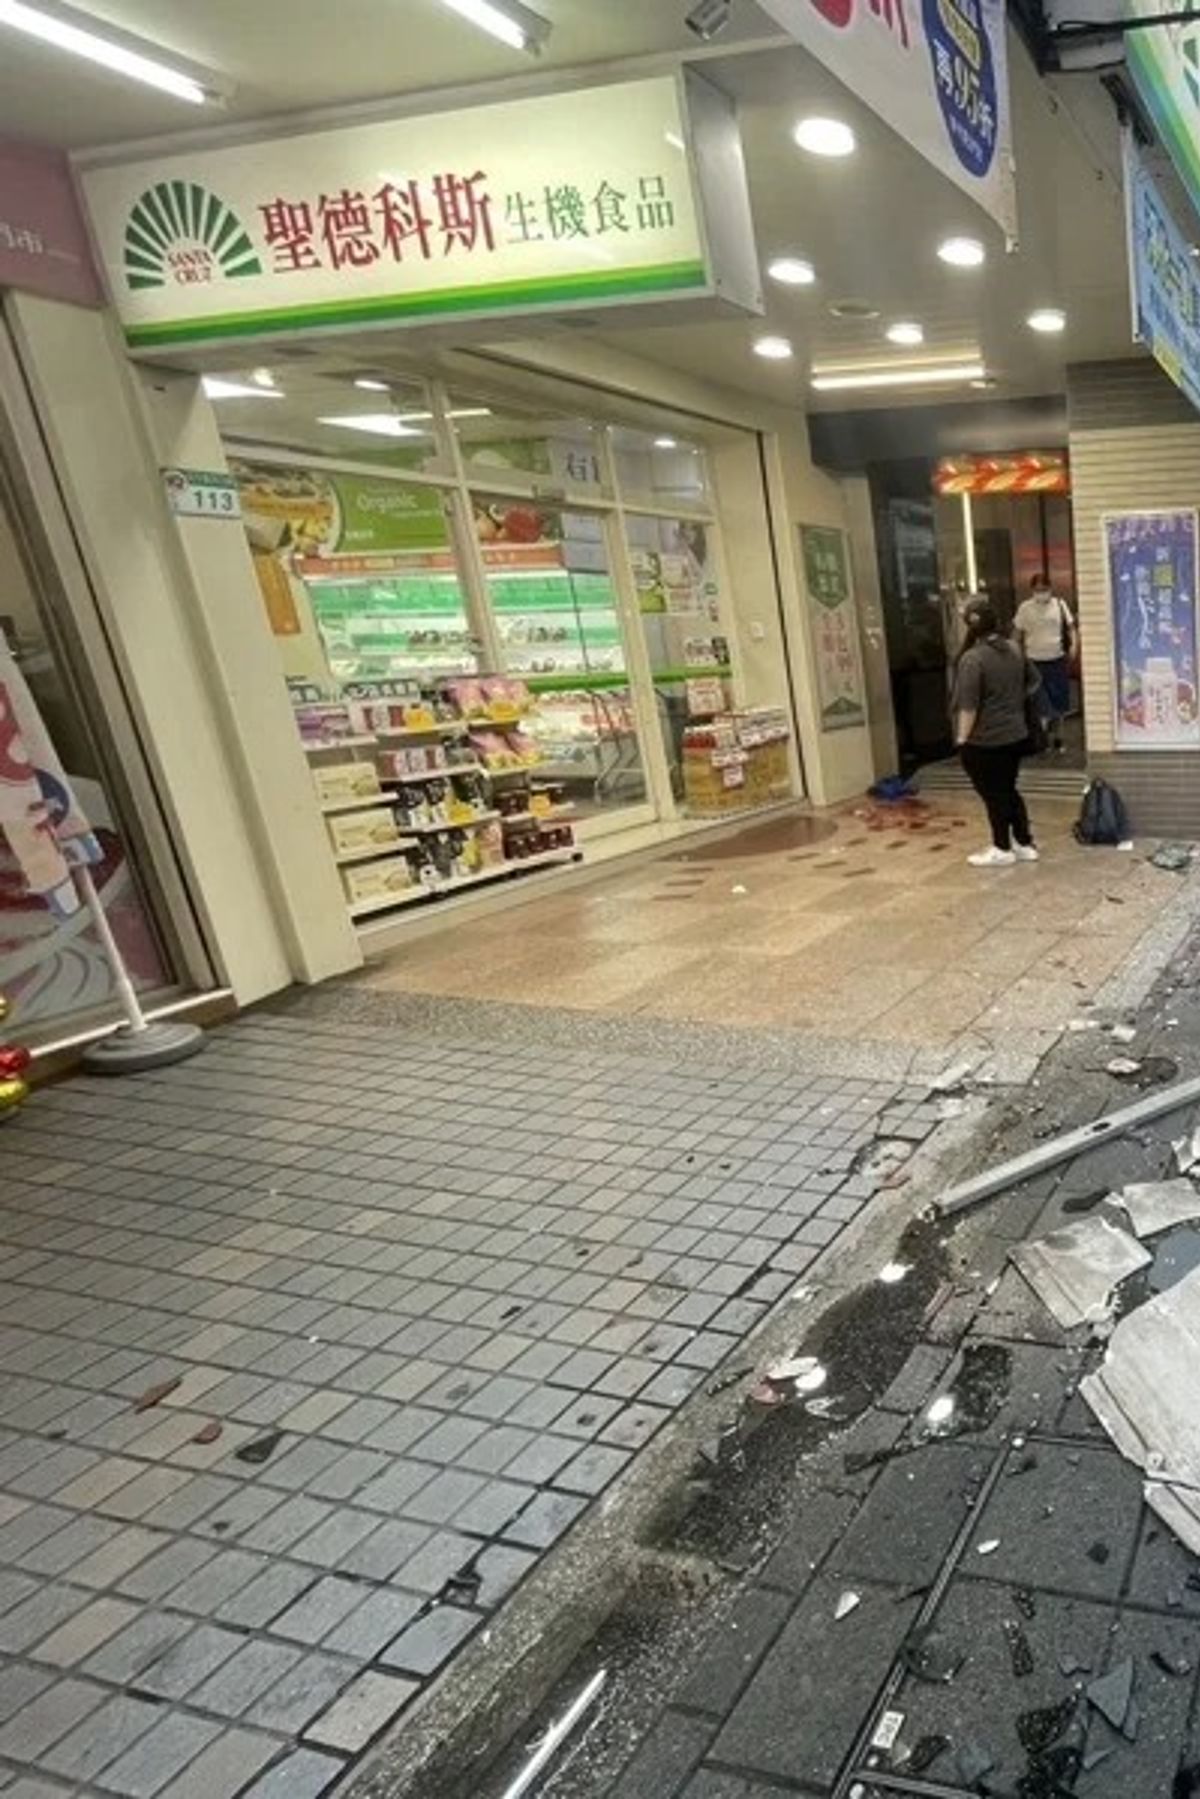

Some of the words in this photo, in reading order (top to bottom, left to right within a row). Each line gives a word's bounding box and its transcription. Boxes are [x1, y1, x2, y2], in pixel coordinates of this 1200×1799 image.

[501, 175, 676, 245] 生機食品
[258, 171, 495, 274] 聖德科斯
[167, 249, 214, 267] SANTA
[174, 266, 212, 285] CRUZ
[192, 489, 233, 511] 113
[356, 492, 419, 515] Organic
